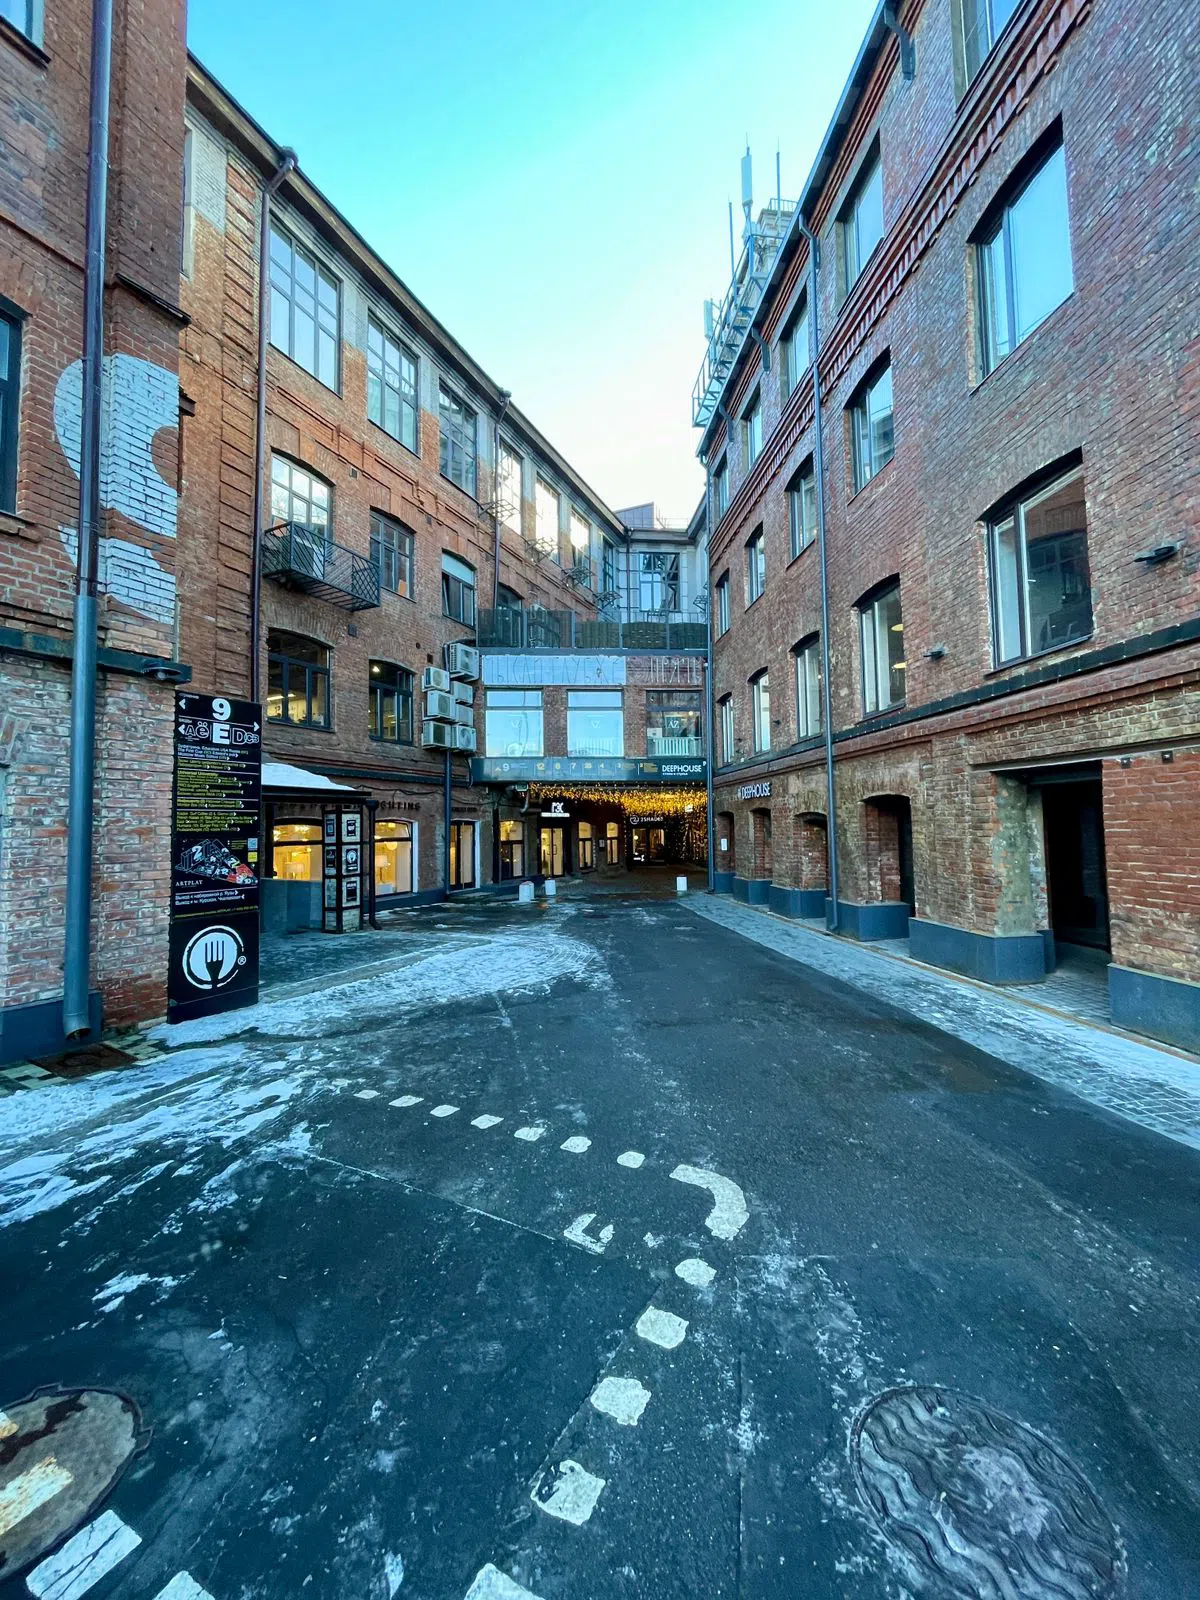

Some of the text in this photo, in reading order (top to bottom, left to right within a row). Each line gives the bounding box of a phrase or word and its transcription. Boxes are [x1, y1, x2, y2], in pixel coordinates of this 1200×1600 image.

[212, 698, 231, 721] 9
[213, 723, 230, 745] E
[661, 764, 702, 773] DEEPHOUSE
[741, 782, 771, 800] DEEPHOUSE
